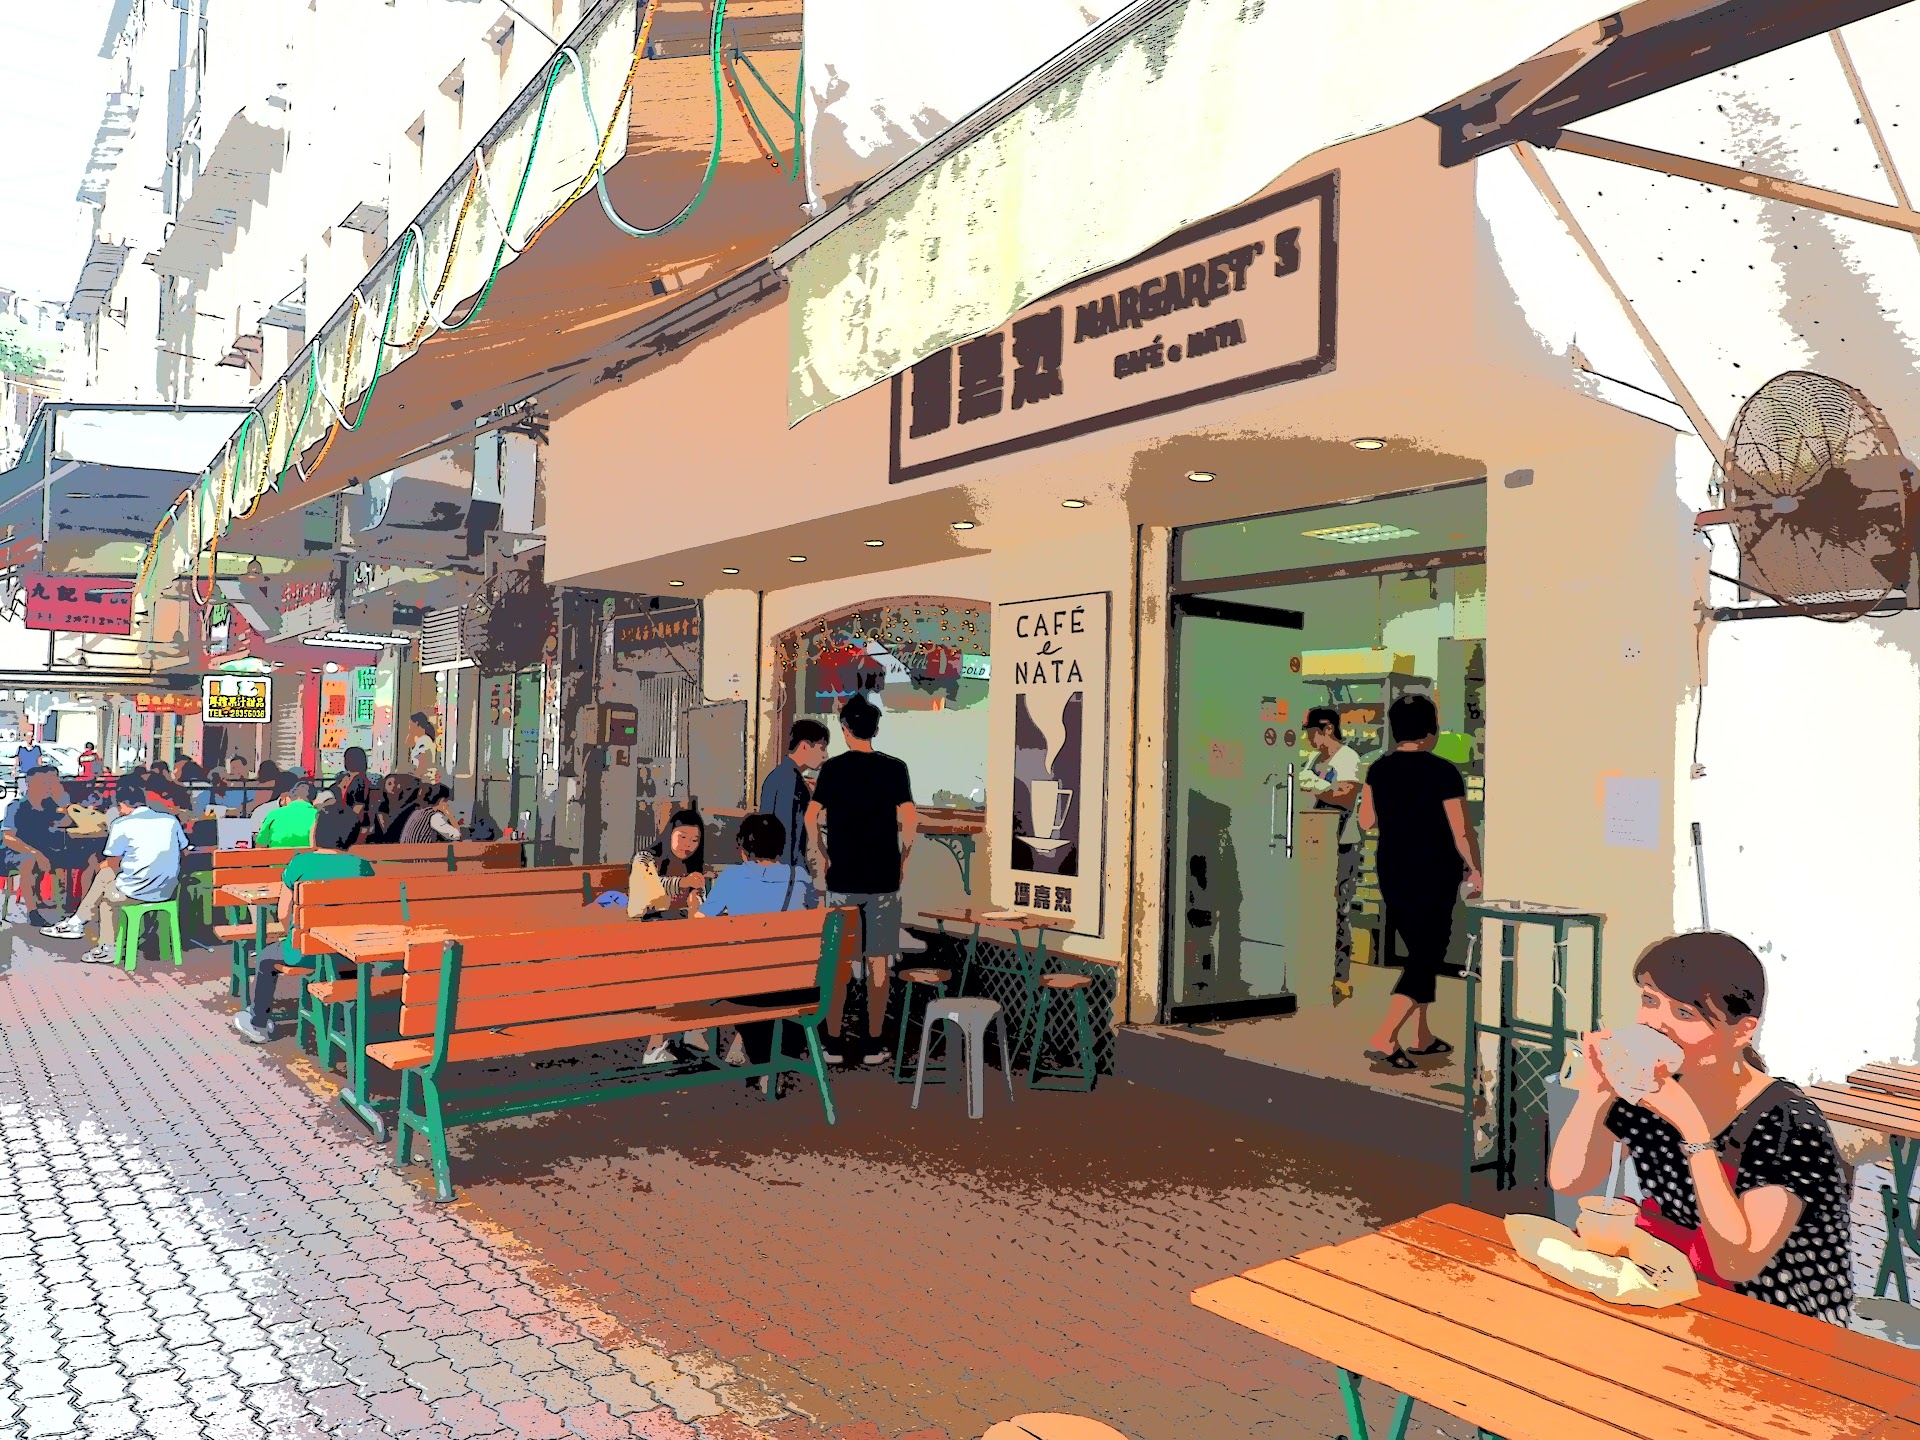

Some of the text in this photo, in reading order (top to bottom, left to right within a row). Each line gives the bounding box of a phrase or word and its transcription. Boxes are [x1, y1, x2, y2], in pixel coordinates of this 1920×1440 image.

[1016, 605, 1085, 638] CAFÉ
[1036, 640, 1063, 656] e
[1015, 659, 1083, 685] NATA
